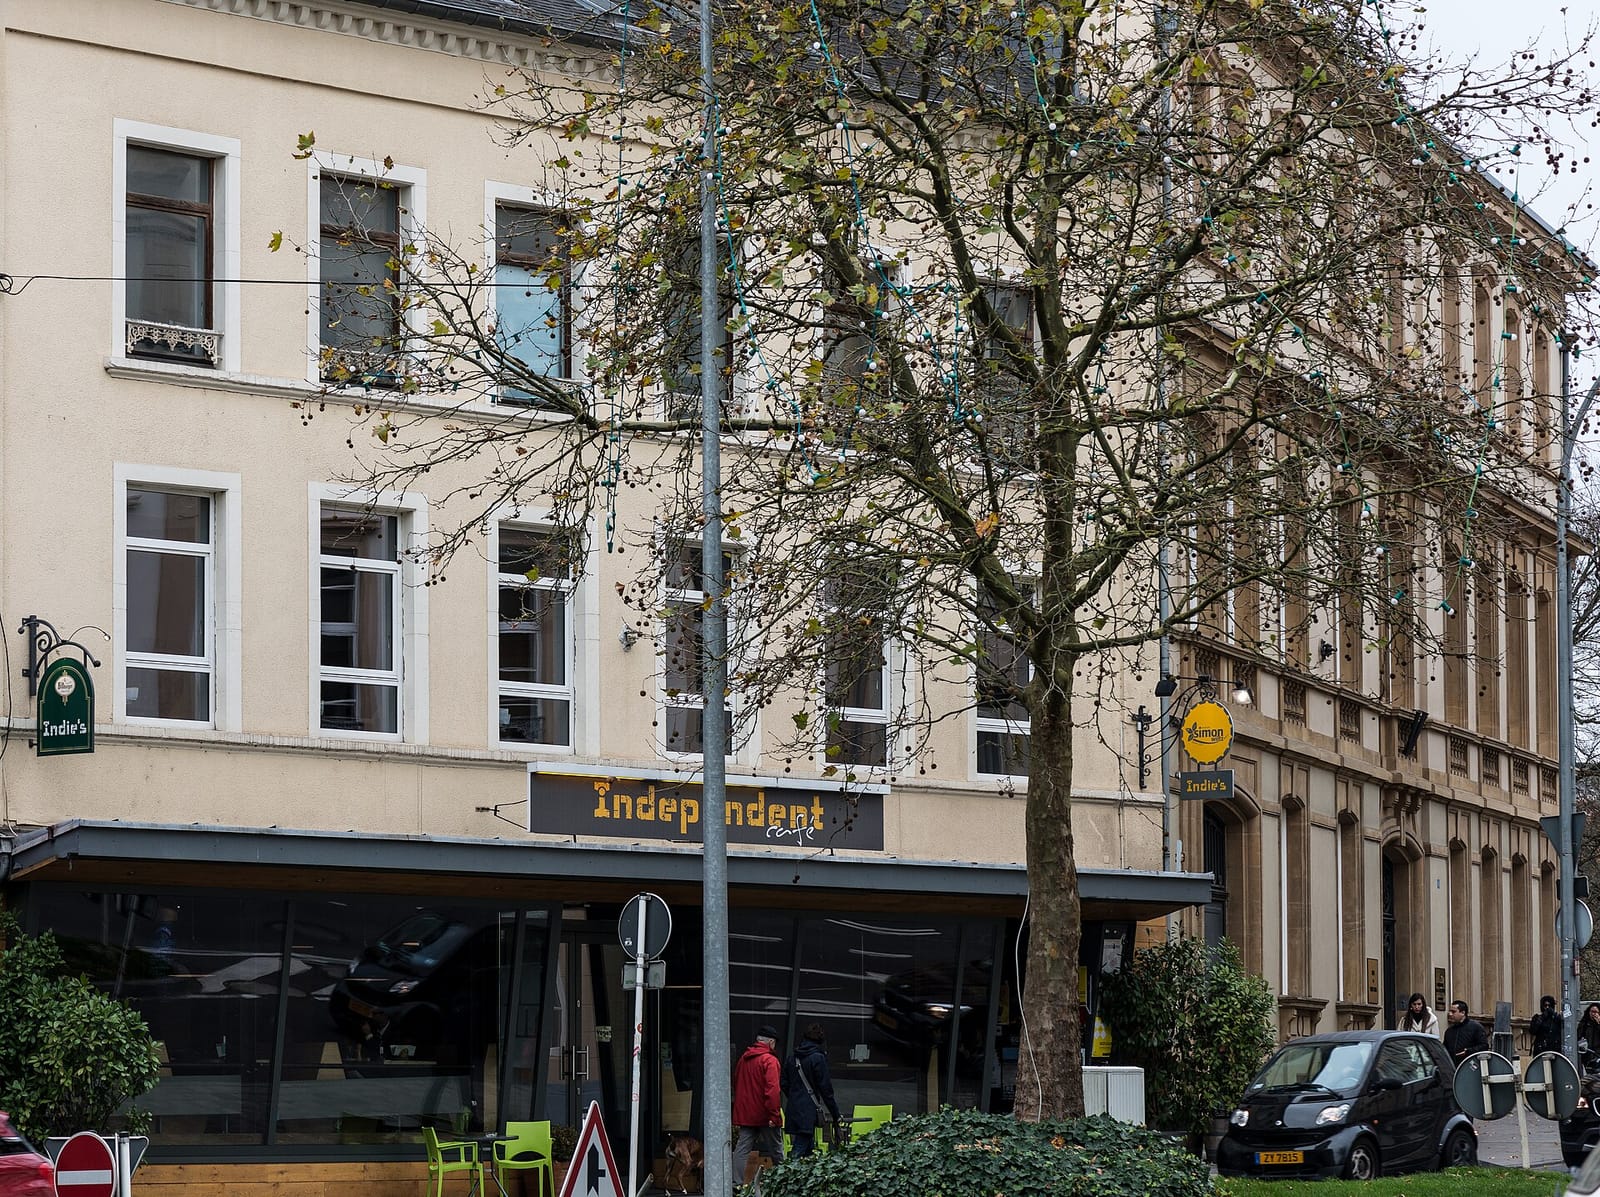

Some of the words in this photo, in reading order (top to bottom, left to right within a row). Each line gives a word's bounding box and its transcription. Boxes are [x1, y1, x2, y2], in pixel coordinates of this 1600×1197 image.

[43, 719, 87, 737] Indie's
[1194, 726, 1224, 738] simon
[1186, 779, 1227, 792] Indie's
[594, 781, 824, 834] Indepndent
[766, 814, 815, 846] café
